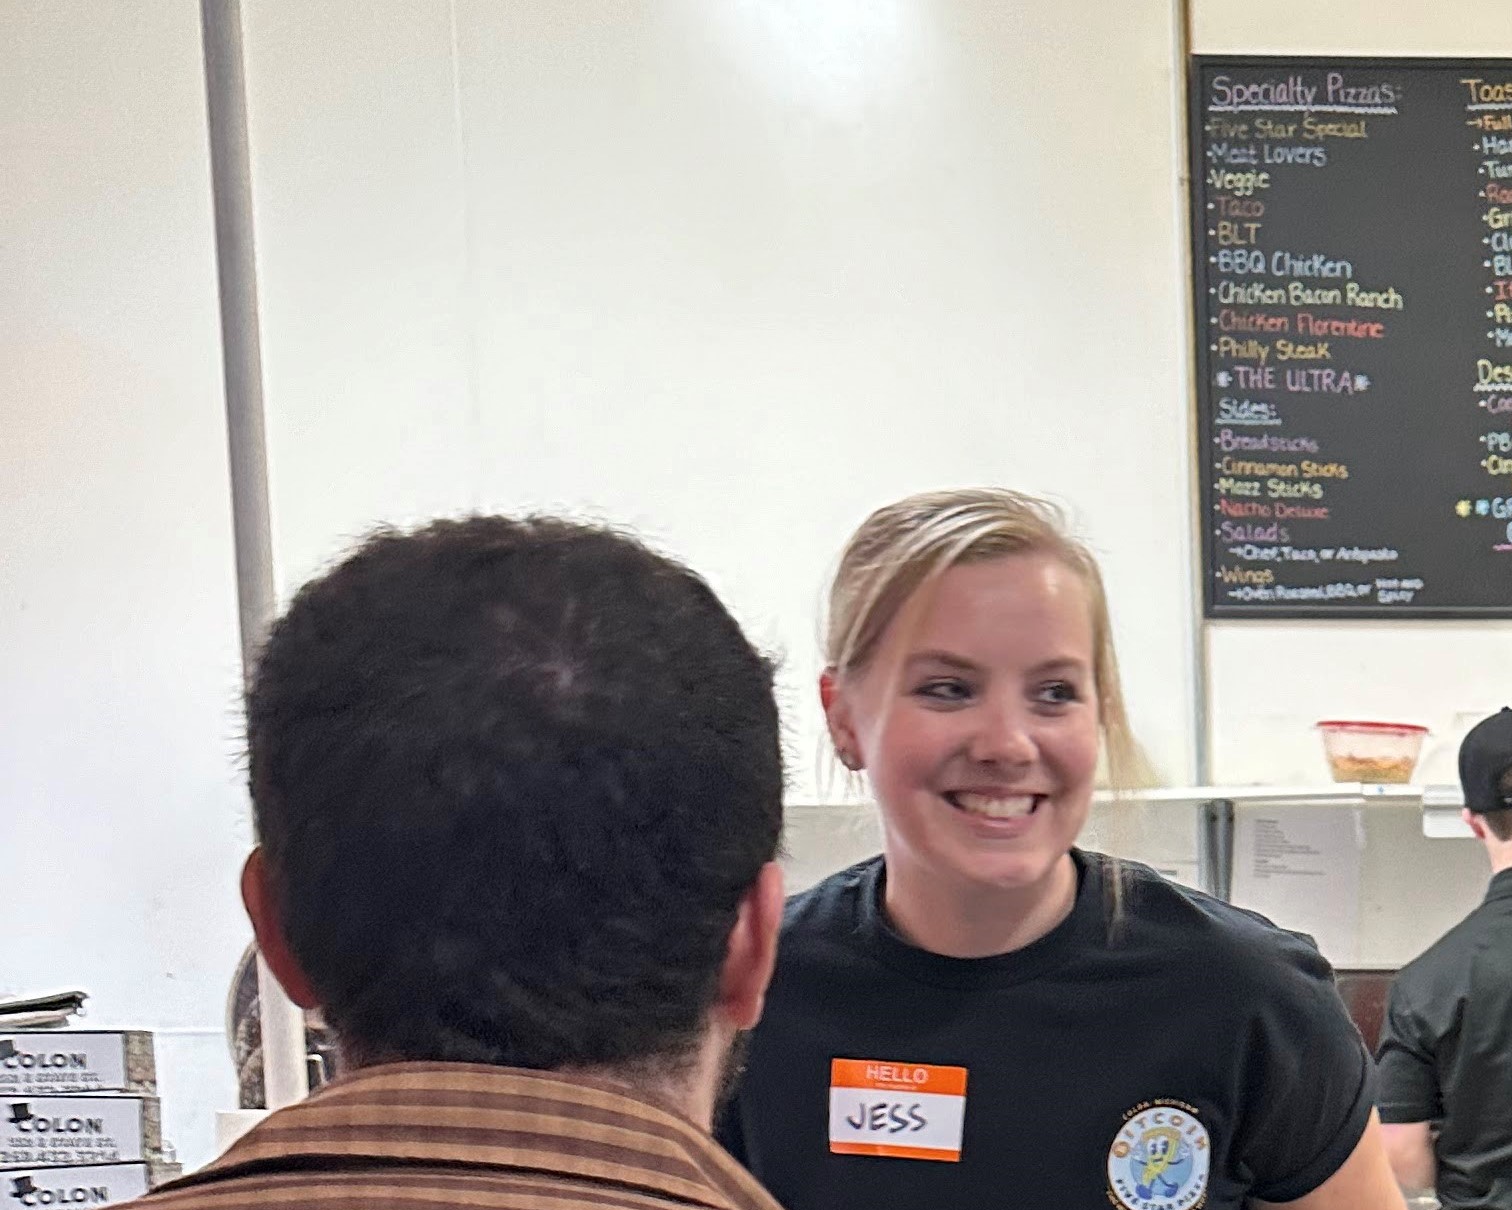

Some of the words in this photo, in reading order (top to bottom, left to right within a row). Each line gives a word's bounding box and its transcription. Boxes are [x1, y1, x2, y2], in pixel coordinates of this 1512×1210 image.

[1211, 75, 1317, 110] Specialty
[1210, 117, 1250, 138] Five
[1255, 116, 1298, 138] Star
[1303, 117, 1368, 140] Special
[1211, 143, 1258, 164] Meat
[1263, 144, 1328, 167] Lovers
[1210, 169, 1271, 196] Veggie
[1216, 196, 1265, 217] Taco
[1217, 221, 1263, 246] BLT
[1217, 249, 1267, 275] BBQ
[1271, 251, 1353, 278] Chicken
[1218, 280, 1287, 304] Chicken
[1287, 282, 1342, 306] Bacon
[1346, 282, 1404, 310] Ranch
[1219, 308, 1289, 332] Chicken
[1297, 312, 1386, 338] Florentine
[1218, 336, 1270, 366] Philly
[1276, 339, 1332, 360] Steak
[1234, 366, 1277, 389] THE
[1286, 368, 1354, 395] ULTRA
[1220, 428, 1320, 453] Breadsticks
[1221, 456, 1298, 477] Cinnamon
[1300, 460, 1349, 480] Sticks
[1218, 477, 1261, 497] Mozz
[1267, 478, 1324, 500] Sticks
[1219, 497, 1272, 518] Nacho
[1275, 501, 1330, 519] Deluxe
[1220, 521, 1291, 544] Salads
[1221, 563, 1275, 586] Wings
[3, 1053, 87, 1070] COLON
[865, 1064, 930, 1084] HELLO
[18, 1117, 104, 1134] COLON
[847, 1102, 929, 1134] JESS
[20, 1185, 110, 1207] COLON
